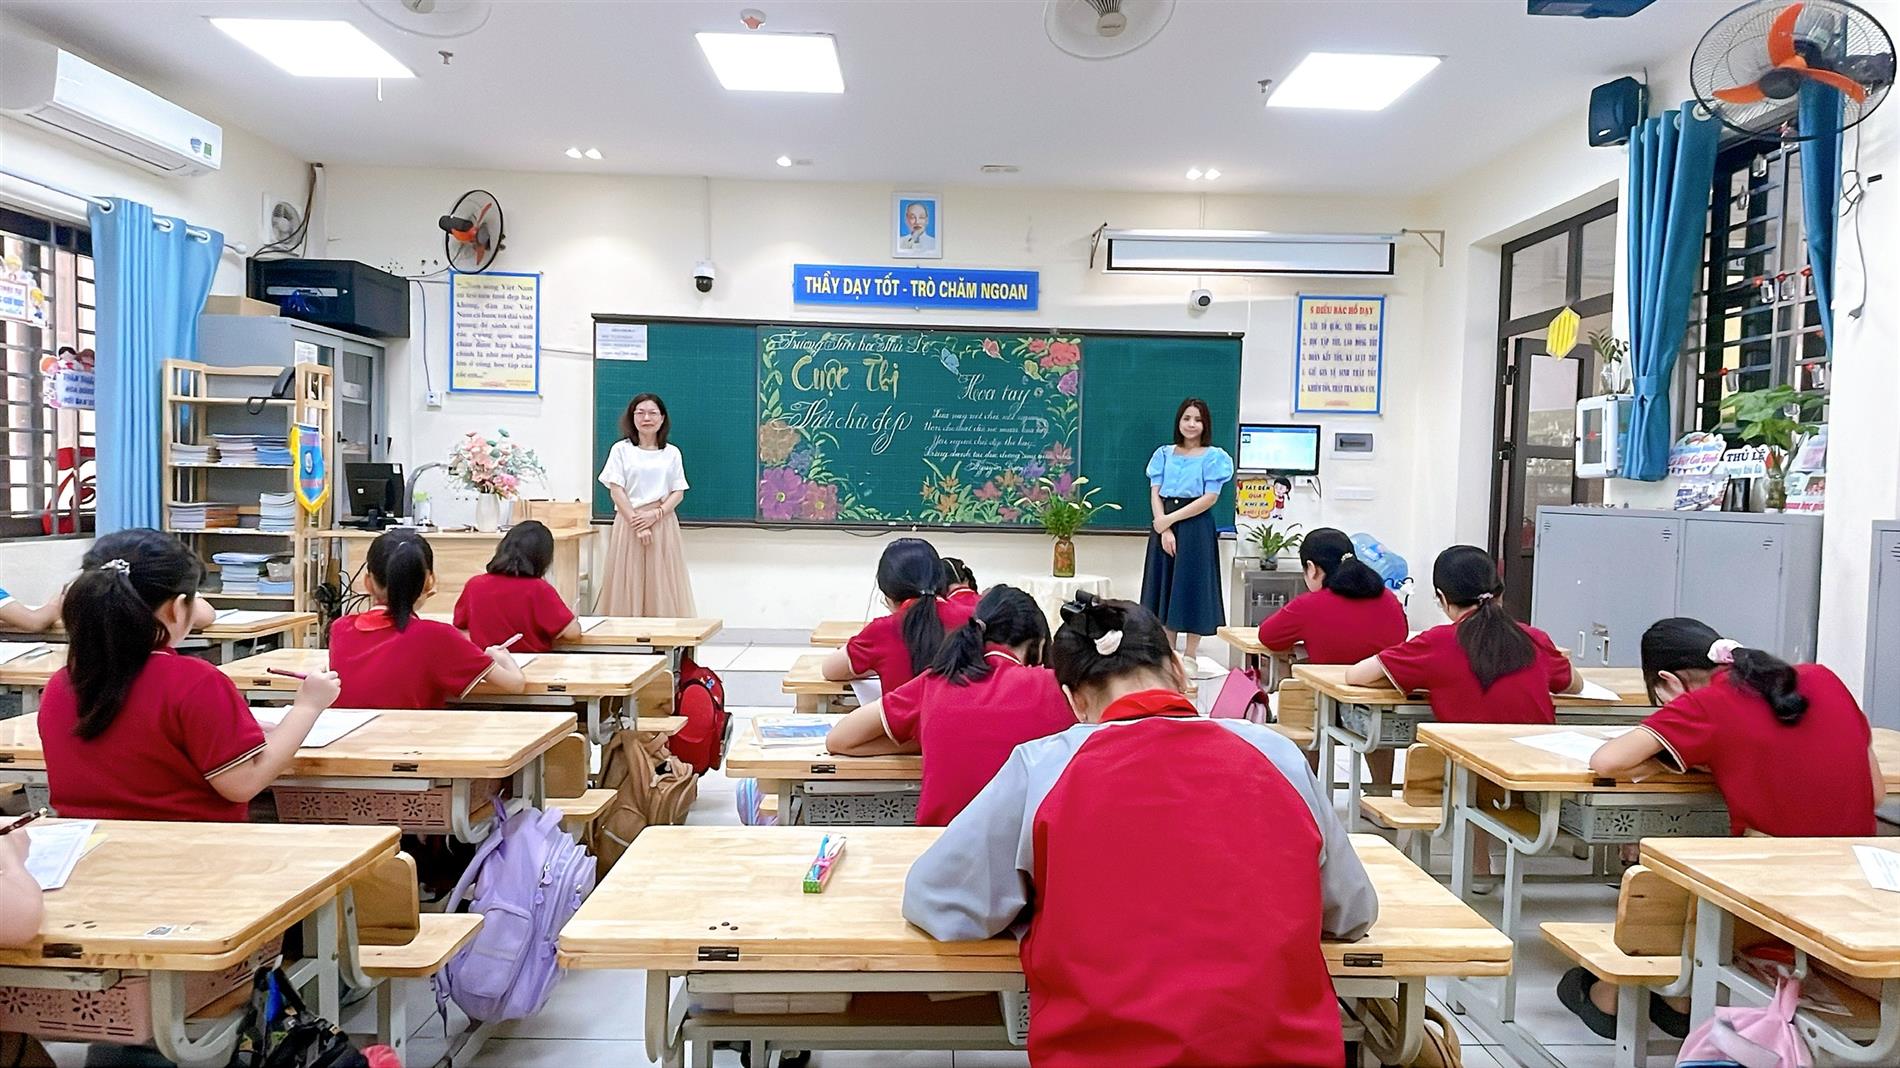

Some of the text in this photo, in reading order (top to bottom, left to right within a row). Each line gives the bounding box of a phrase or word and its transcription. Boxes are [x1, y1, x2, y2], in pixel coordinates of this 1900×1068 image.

[804, 270, 839, 295] THẦY
[843, 278, 871, 299] DẠY
[875, 272, 899, 296] TỐT
[910, 276, 935, 298] TRÒ
[939, 276, 977, 299] CHĂM
[981, 283, 1028, 300] NGOAN
[1310, 306, 1314, 314] 5
[792, 355, 850, 397] Cuộc
[958, 373, 1031, 416] Hoa tay
[835, 402, 869, 430] chữ
[868, 405, 912, 455] đẹp
[1727, 449, 1749, 462] THỦ
[1752, 447, 1765, 463] LỆ
